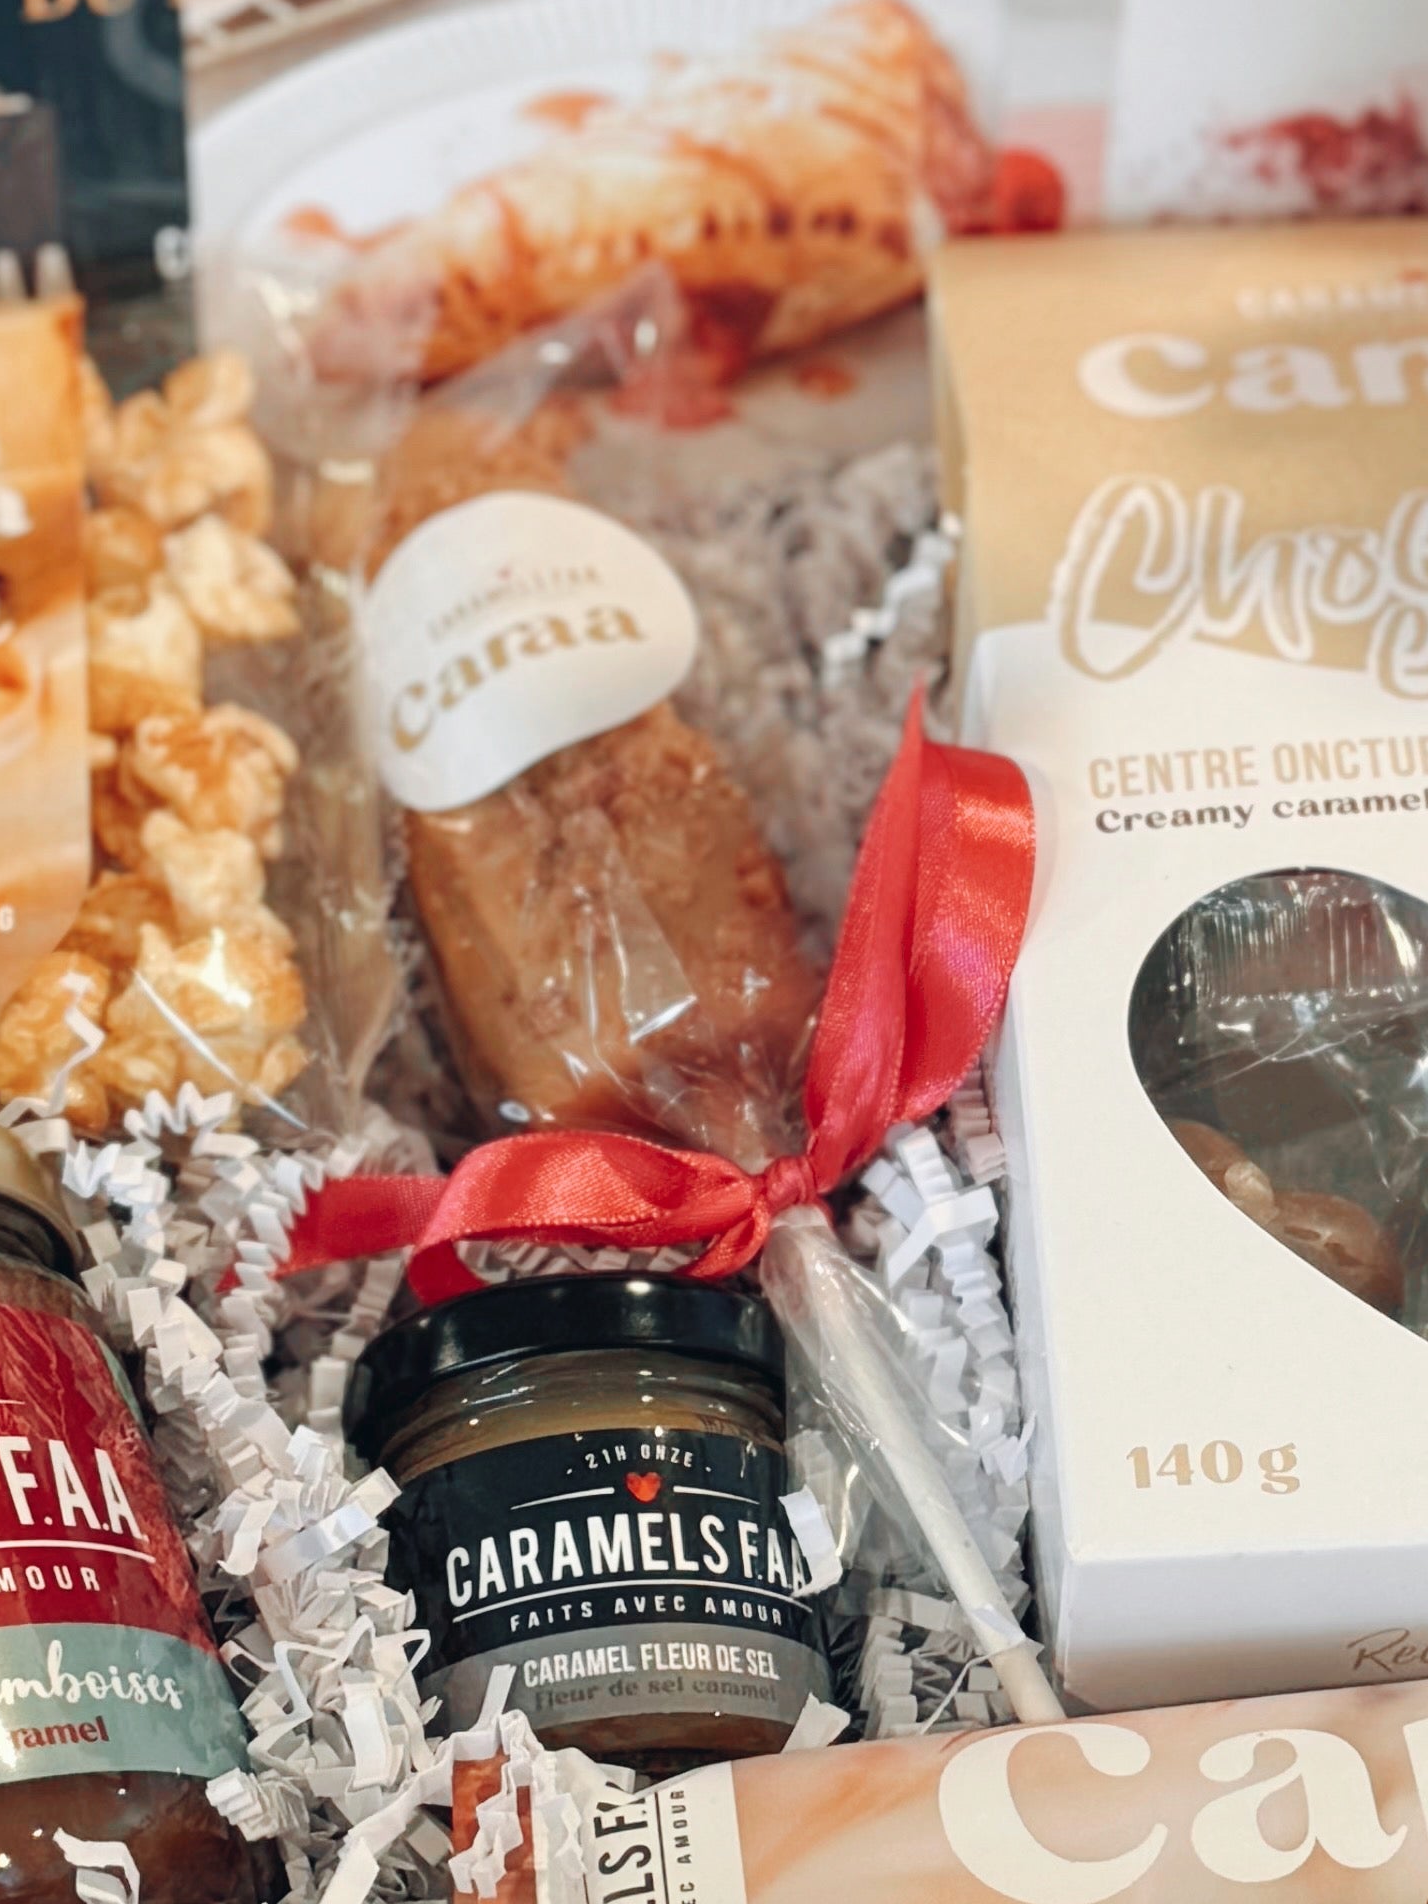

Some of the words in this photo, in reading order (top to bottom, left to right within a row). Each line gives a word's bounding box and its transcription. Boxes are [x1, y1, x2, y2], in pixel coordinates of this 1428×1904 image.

[389, 605, 648, 755] Caraa
[1087, 746, 1257, 801] CENTRE
[1094, 800, 1255, 836] Creamy
[585, 1444, 628, 1471] 21H
[640, 1443, 694, 1469] ONZE
[1124, 1438, 1244, 1490] 140
[1257, 1440, 1302, 1495] g
[445, 1511, 730, 1608] CARAMELS
[509, 1600, 593, 1633] FAITS
[614, 1594, 687, 1615] AVEC
[704, 1596, 783, 1627] AMOUR
[523, 1645, 636, 1688] CARAMEL
[639, 1642, 712, 1672] FLEUR
[715, 1643, 744, 1673] DE
[746, 1648, 781, 1681] SEL
[609, 1677, 639, 1697] de
[647, 1675, 684, 1696] sel
[669, 1789, 693, 1865] AMOUR
